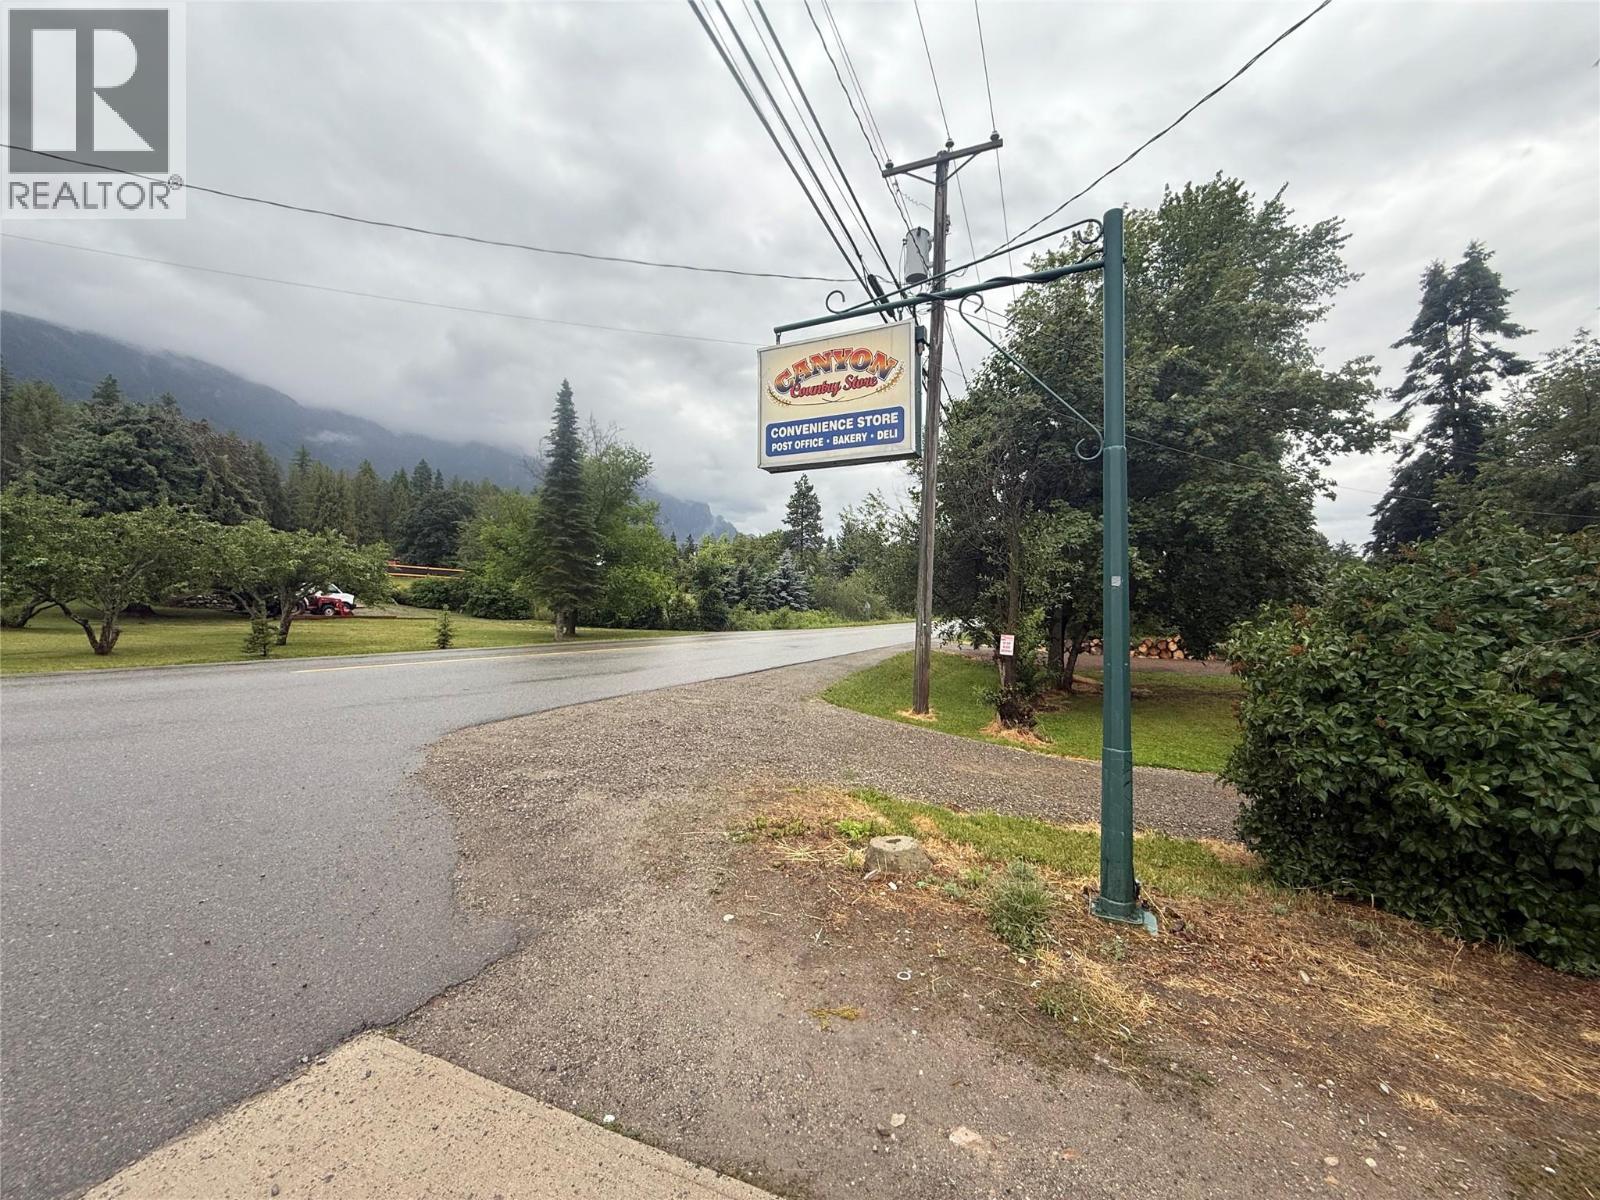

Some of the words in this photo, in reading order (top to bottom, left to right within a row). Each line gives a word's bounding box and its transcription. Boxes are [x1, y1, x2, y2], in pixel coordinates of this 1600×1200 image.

[774, 347, 898, 395] CANYON
[790, 380, 841, 398] Country
[843, 374, 878, 391] Store
[771, 418, 854, 438] CONVENIENCE
[857, 412, 899, 427] STORE
[771, 441, 793, 452] POST
[794, 437, 824, 450] OFFICE
[833, 432, 867, 445] BAKERY
[877, 429, 898, 440] DELI
